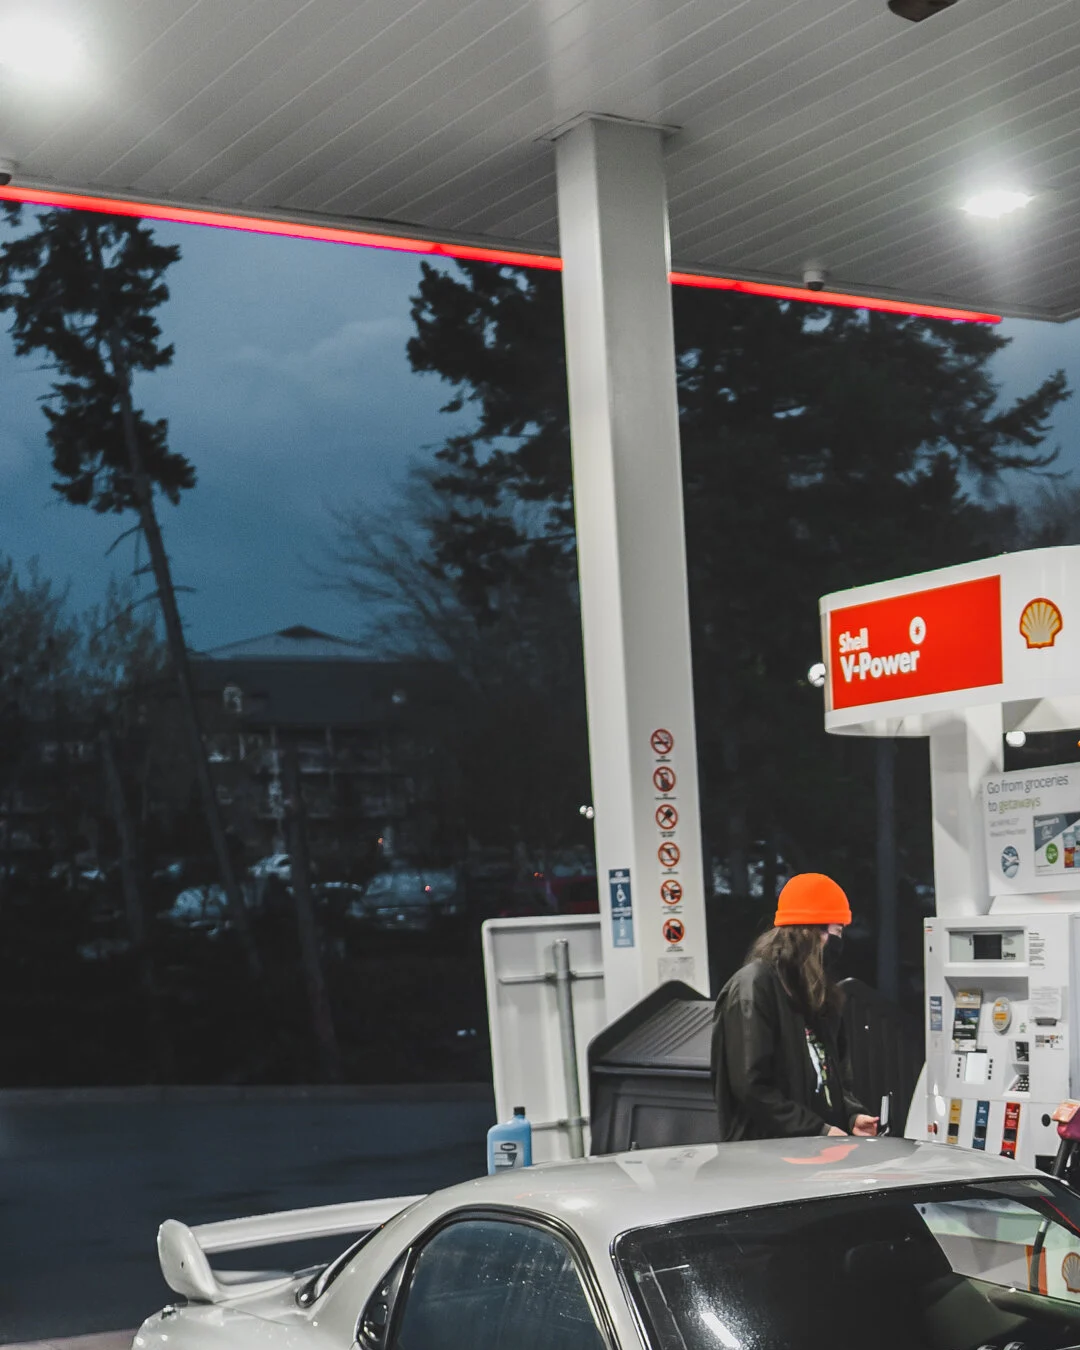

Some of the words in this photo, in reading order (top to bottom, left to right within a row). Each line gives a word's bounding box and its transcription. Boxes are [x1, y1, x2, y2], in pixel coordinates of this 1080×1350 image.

[839, 627, 868, 653] Shell
[840, 650, 920, 683] V-Power
[987, 782, 1000, 794] Go
[1001, 780, 1023, 792] from
[1024, 776, 1069, 793] groceries
[988, 801, 997, 812] to
[999, 797, 1041, 814] getaways
